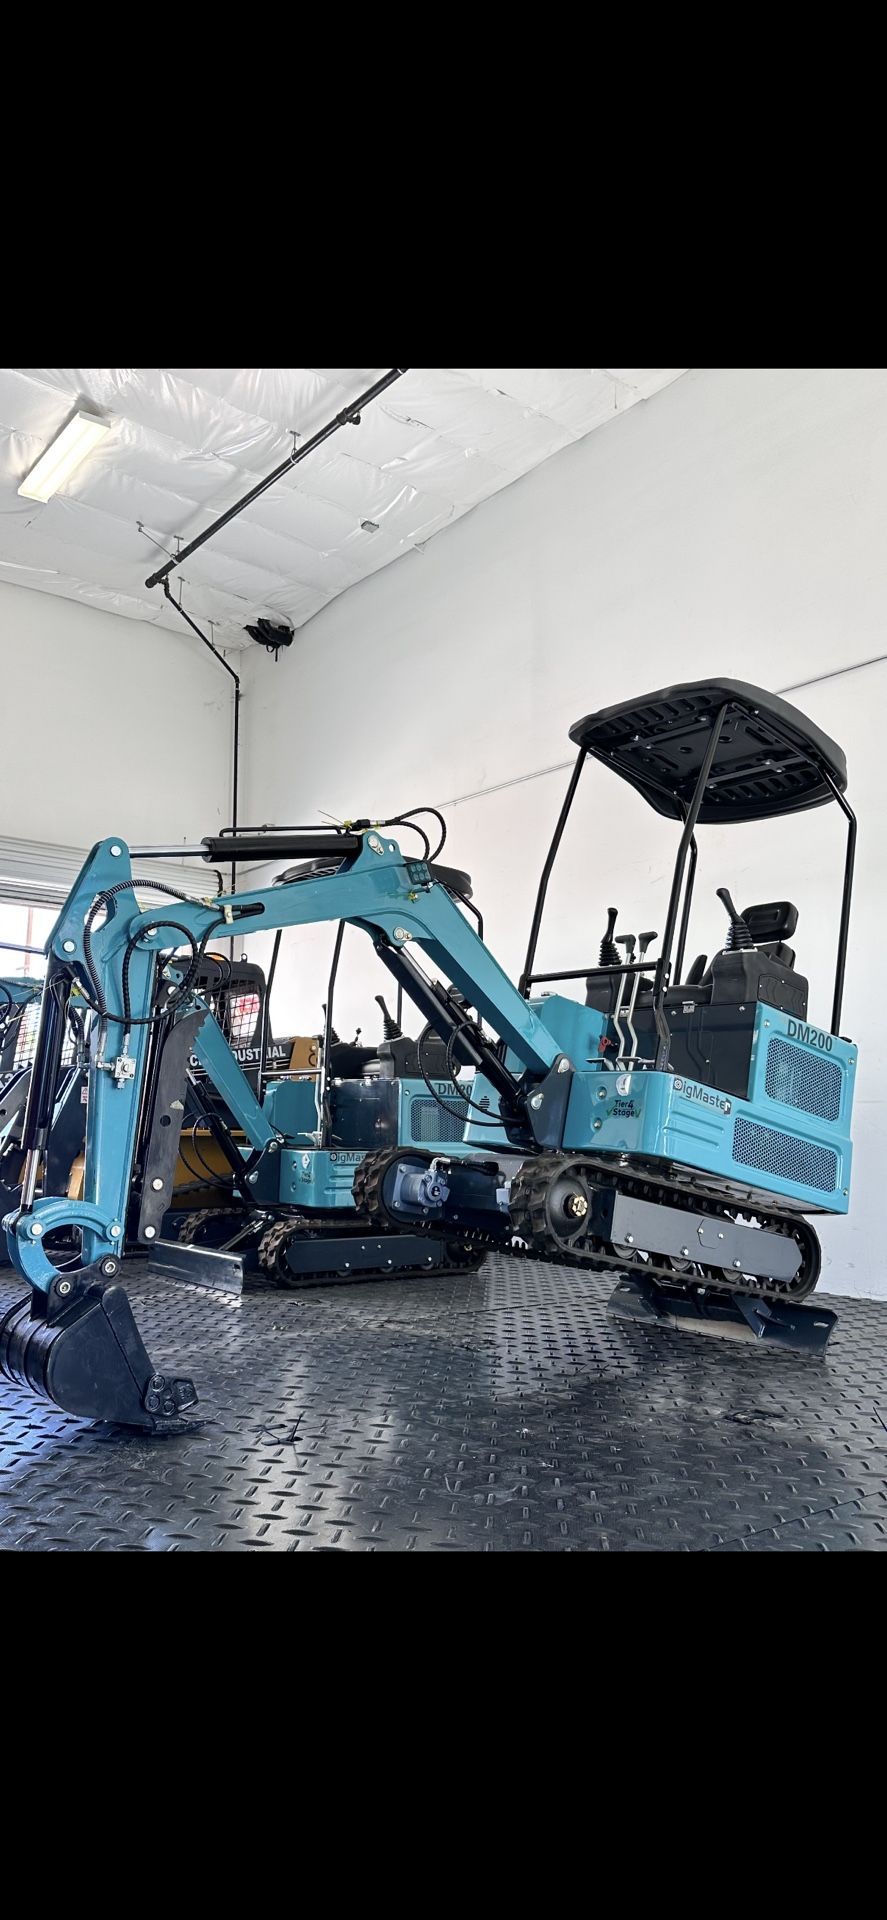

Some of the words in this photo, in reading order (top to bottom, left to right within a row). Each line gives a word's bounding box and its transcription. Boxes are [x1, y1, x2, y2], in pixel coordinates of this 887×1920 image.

[787, 1019, 833, 1052] DM200
[613, 1108, 635, 1118] Stage
[673, 1078, 732, 1115] DigMaster
